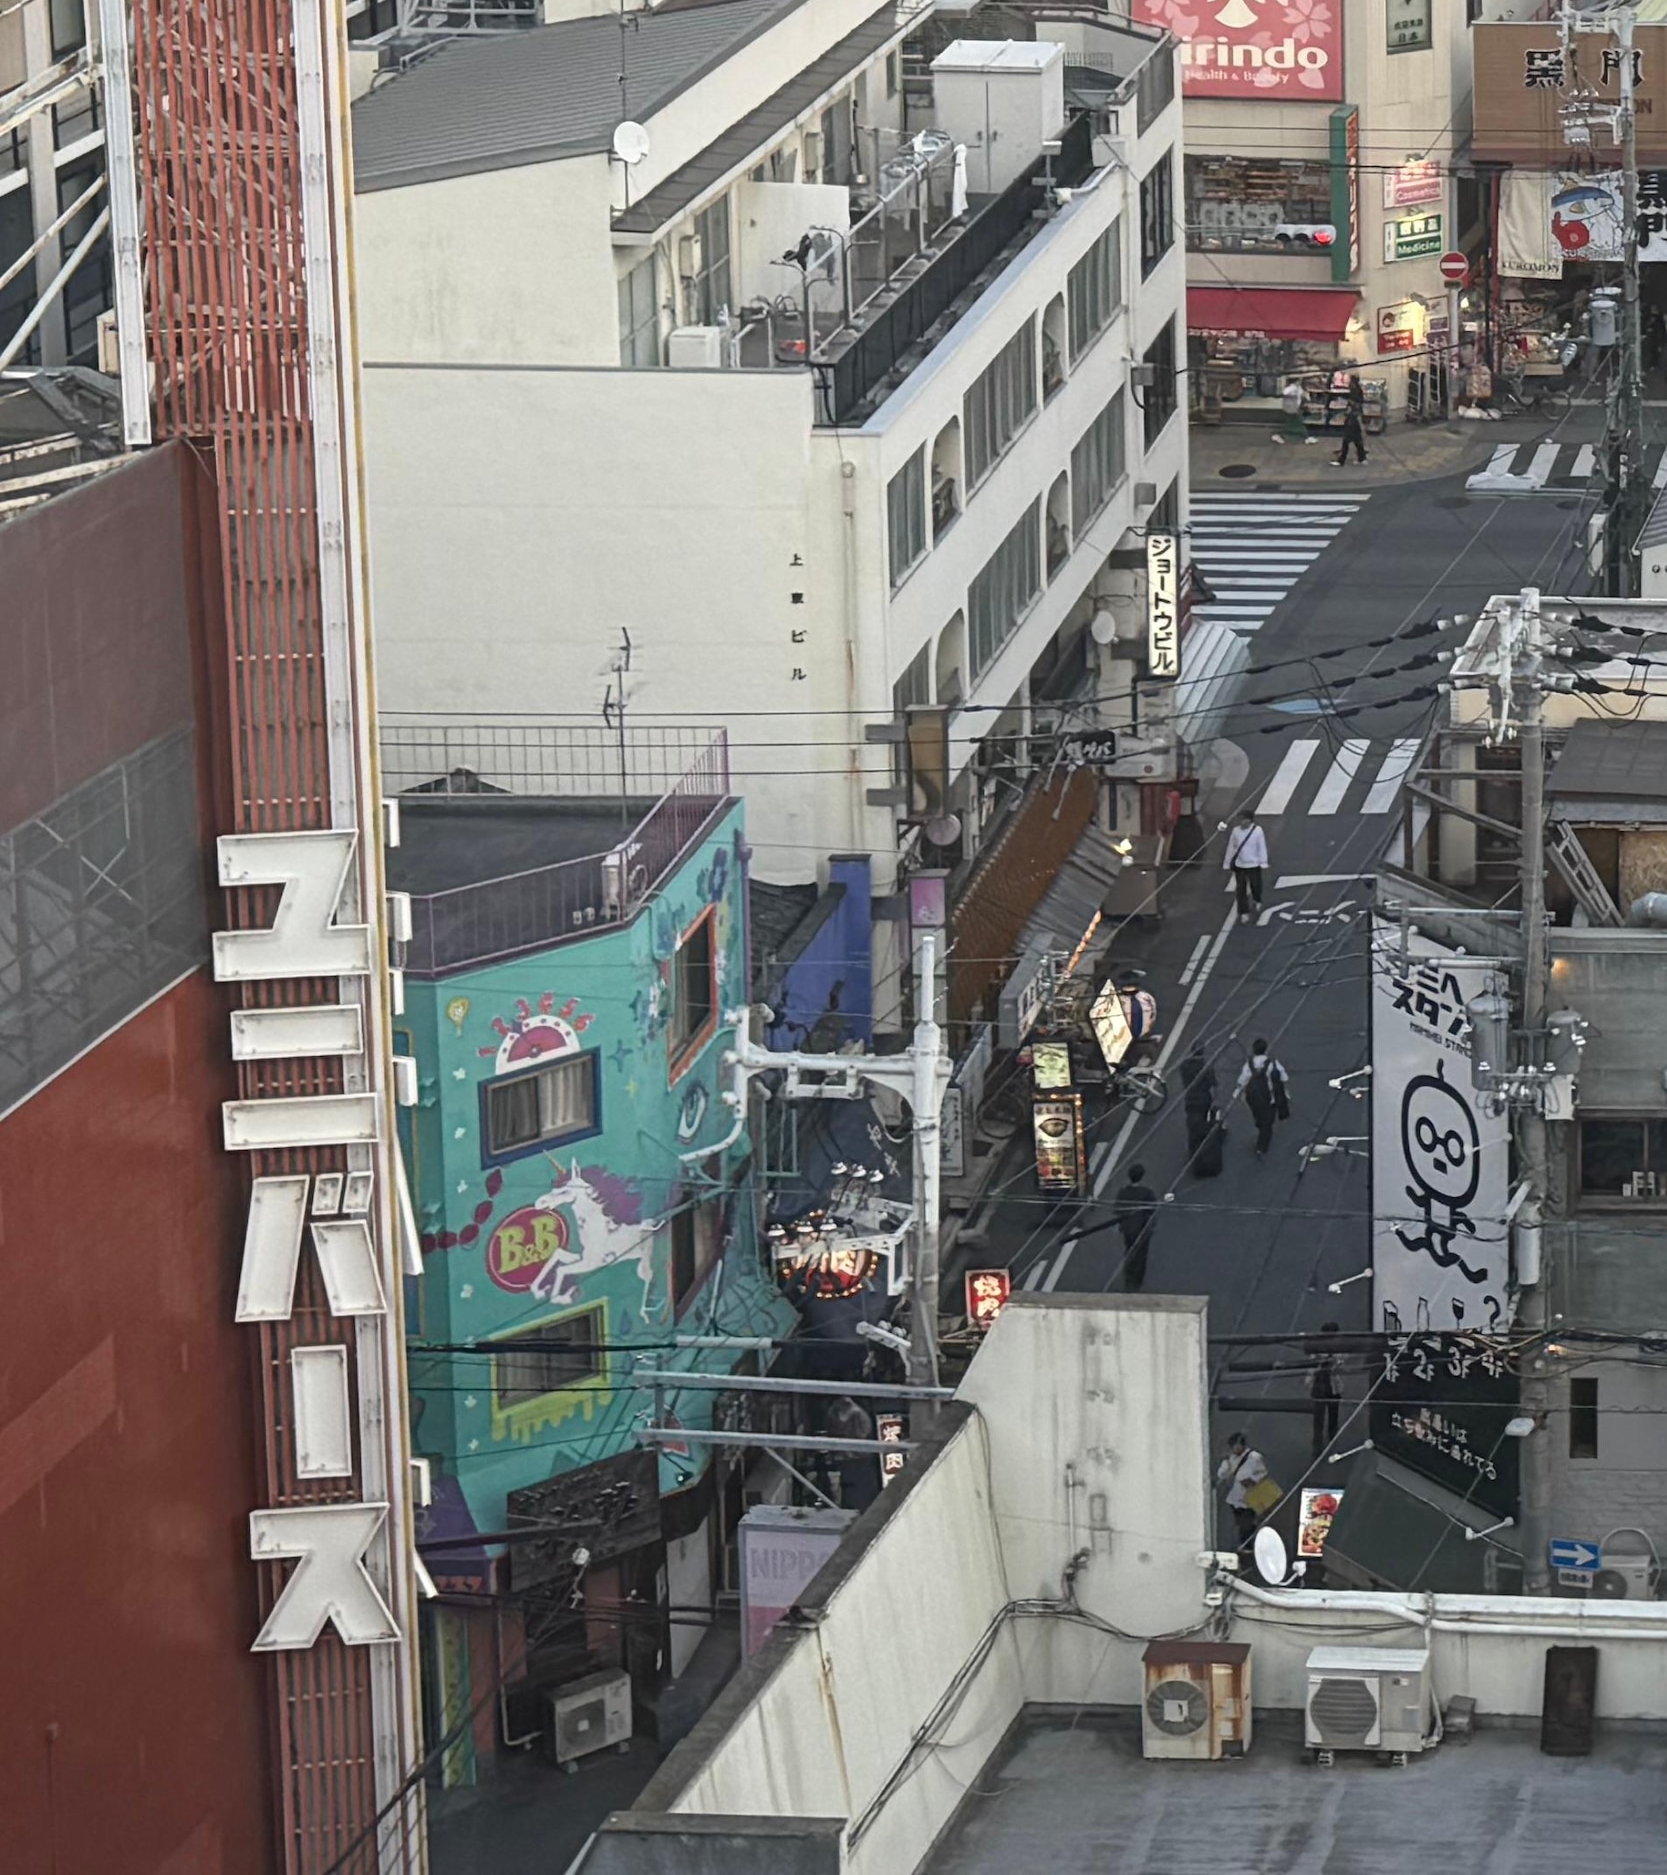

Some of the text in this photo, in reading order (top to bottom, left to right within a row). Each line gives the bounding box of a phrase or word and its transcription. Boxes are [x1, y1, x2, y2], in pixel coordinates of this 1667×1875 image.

[1180, 36, 1328, 69] irindo
[1398, 240, 1441, 255] Medicine
[1151, 538, 1174, 671] ジョートウビル
[213, 827, 401, 1651] ユニバース
[495, 1215, 561, 1275] B&B
[1412, 1347, 1435, 1382] 2F
